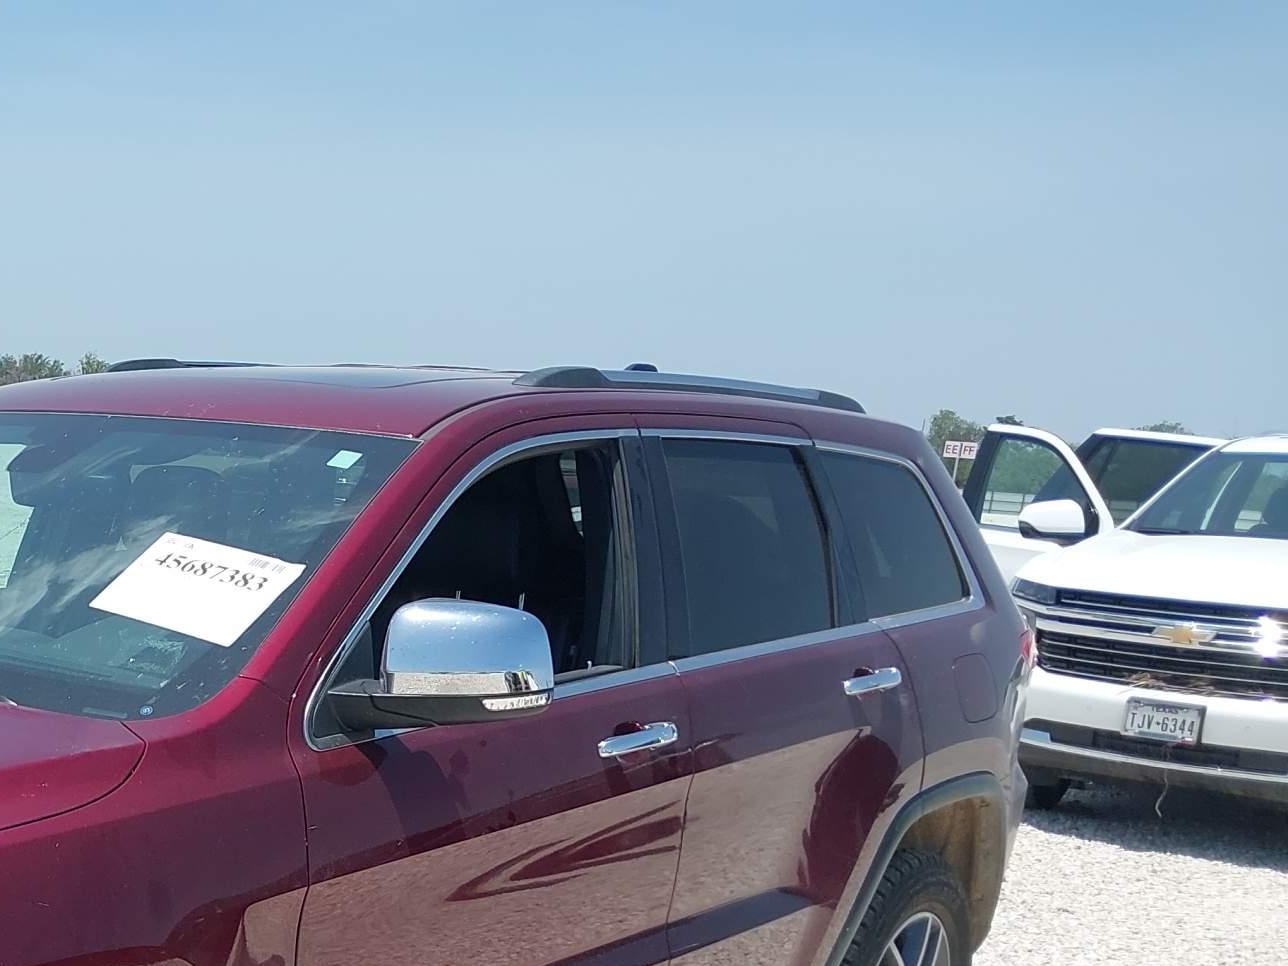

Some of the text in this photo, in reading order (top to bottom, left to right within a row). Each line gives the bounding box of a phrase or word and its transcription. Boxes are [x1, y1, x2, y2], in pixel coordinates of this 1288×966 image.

[945, 444, 976, 456] EE FF
[154, 552, 269, 592] 45687383
